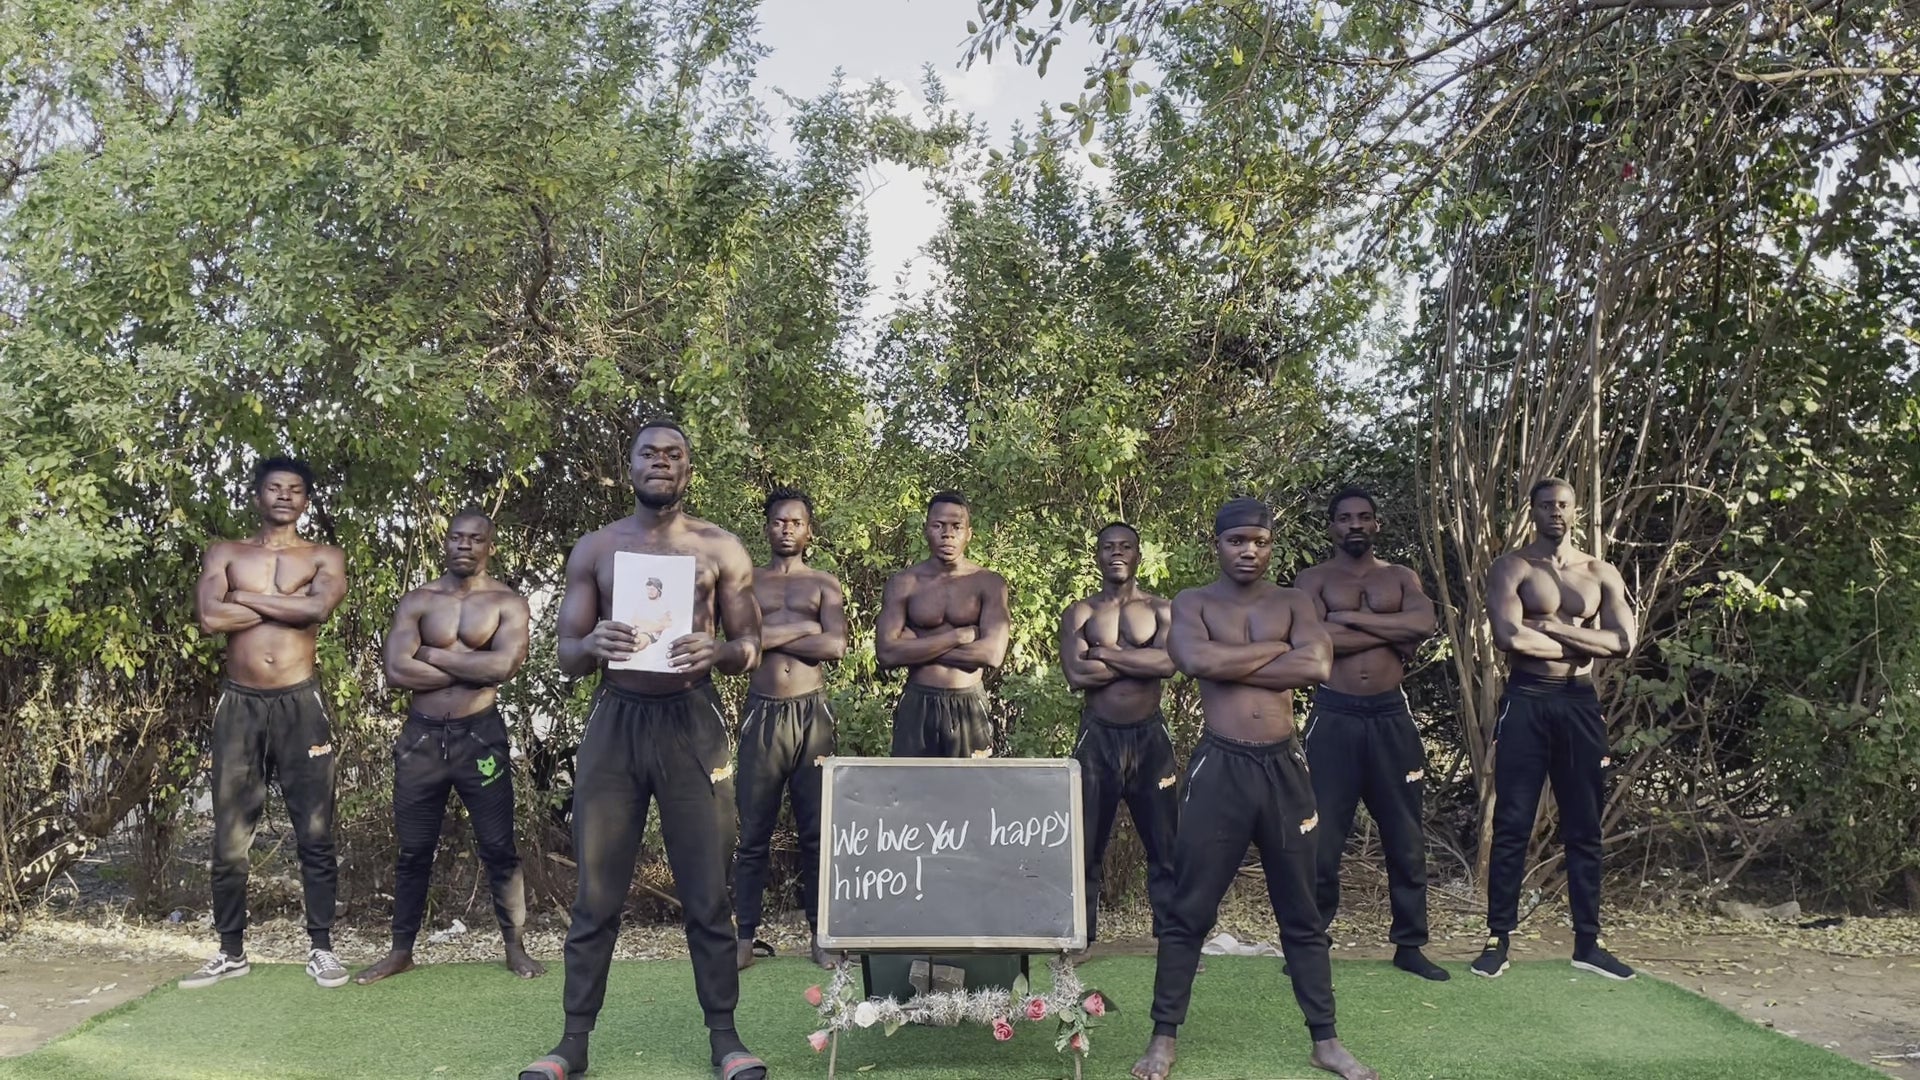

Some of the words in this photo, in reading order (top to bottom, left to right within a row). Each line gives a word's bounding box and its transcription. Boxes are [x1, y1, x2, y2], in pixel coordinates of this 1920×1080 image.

[833, 821, 869, 856] We
[877, 818, 924, 852] love
[990, 807, 1069, 847] happy
[834, 856, 923, 901] hippo!
